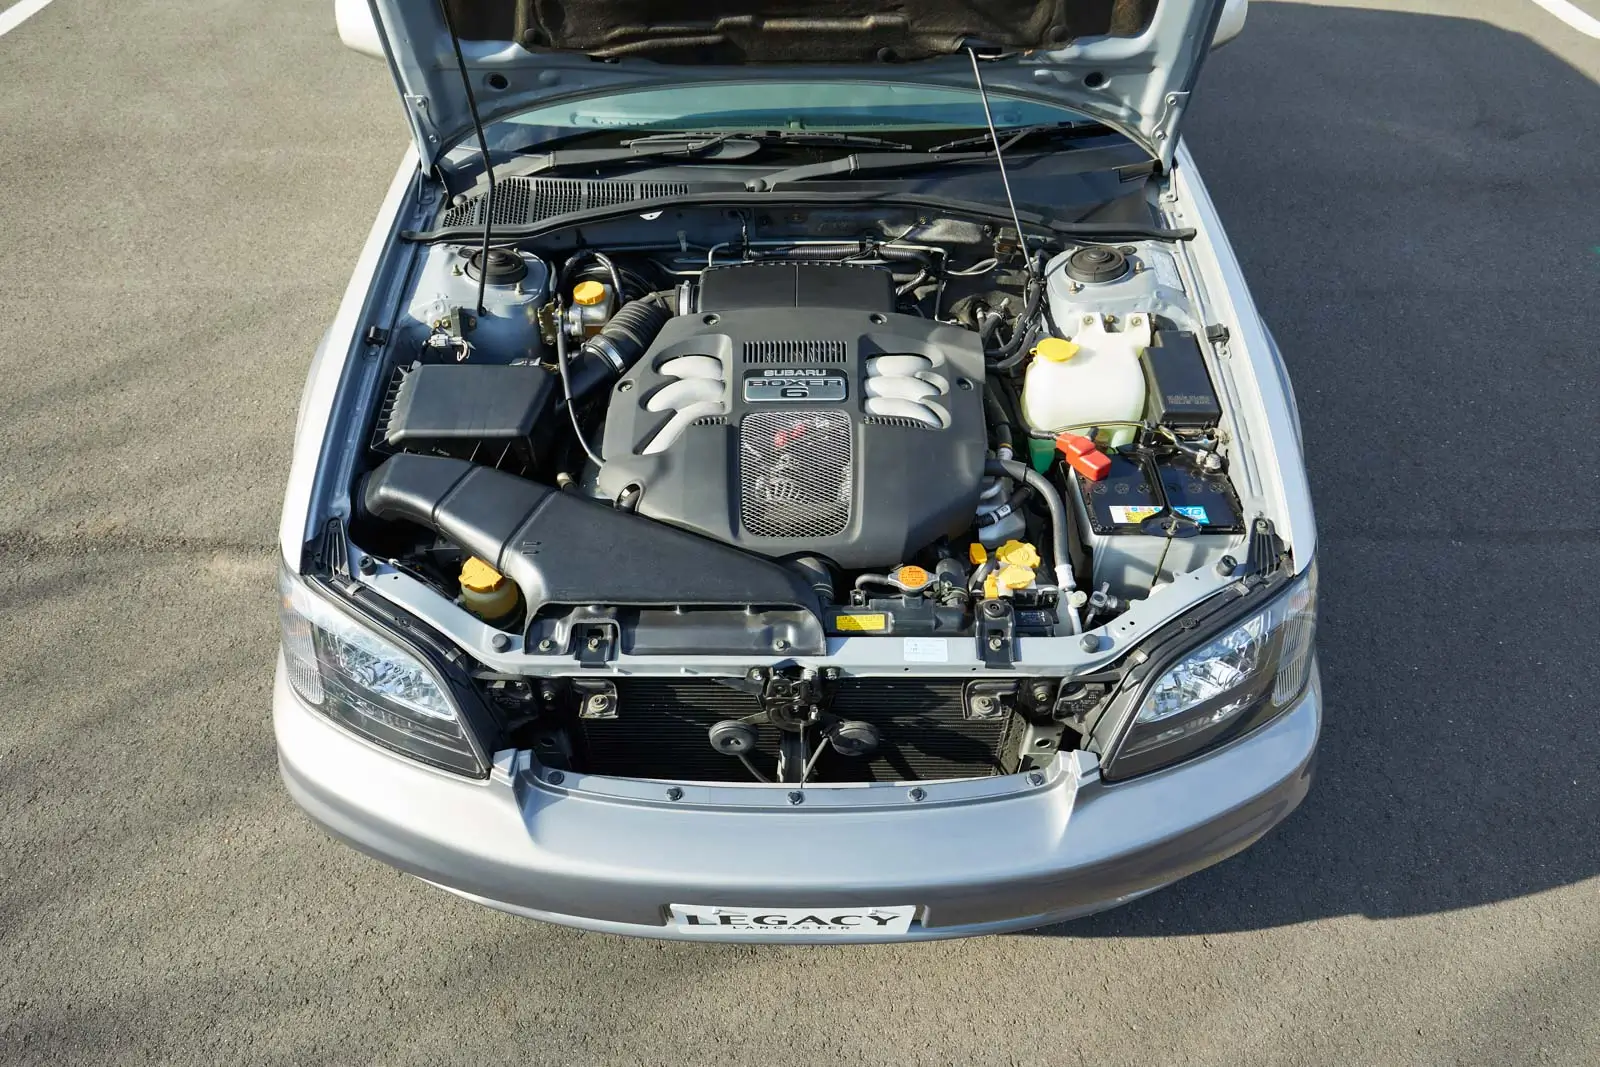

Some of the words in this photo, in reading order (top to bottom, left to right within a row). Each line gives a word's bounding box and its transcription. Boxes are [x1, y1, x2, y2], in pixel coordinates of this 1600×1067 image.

[764, 369, 827, 377] SUBARU
[748, 379, 842, 387] BOXER
[780, 386, 809, 398] 6
[686, 914, 900, 926] LEGACY
